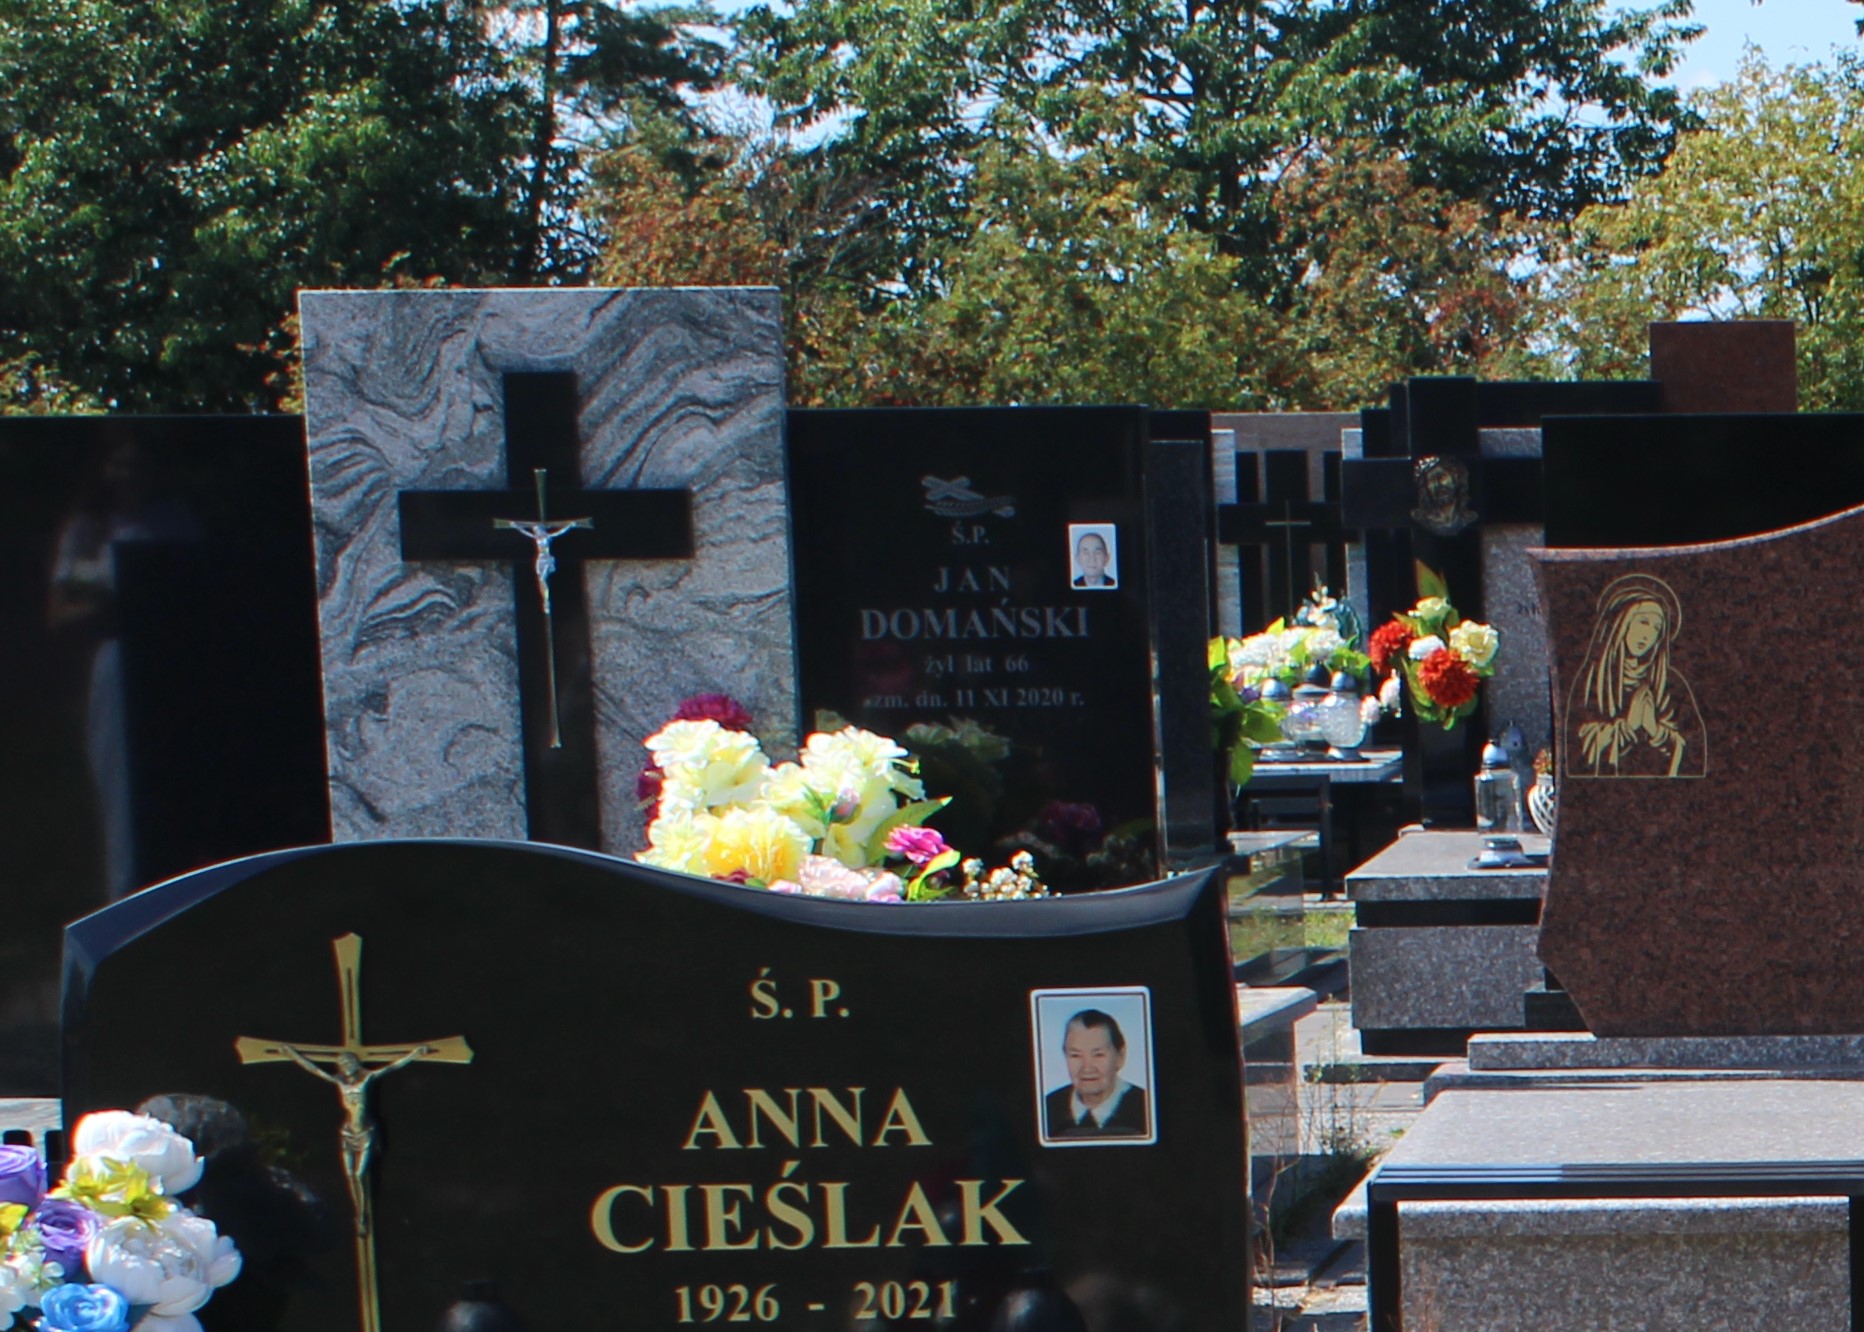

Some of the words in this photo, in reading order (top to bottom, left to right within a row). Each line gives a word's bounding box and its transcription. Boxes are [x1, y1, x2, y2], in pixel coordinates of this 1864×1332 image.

[860, 598, 1090, 641] DOMAŃSKI
[966, 655, 993, 673] lat
[1005, 655, 1030, 673] 66
[749, 965, 792, 1019] Ś.
[810, 979, 850, 1019] P.
[682, 1086, 934, 1151] ANNA
[588, 1160, 1032, 1254] CIEŚLAK
[674, 1283, 780, 1324] 1926
[852, 1280, 958, 1321] 2021
